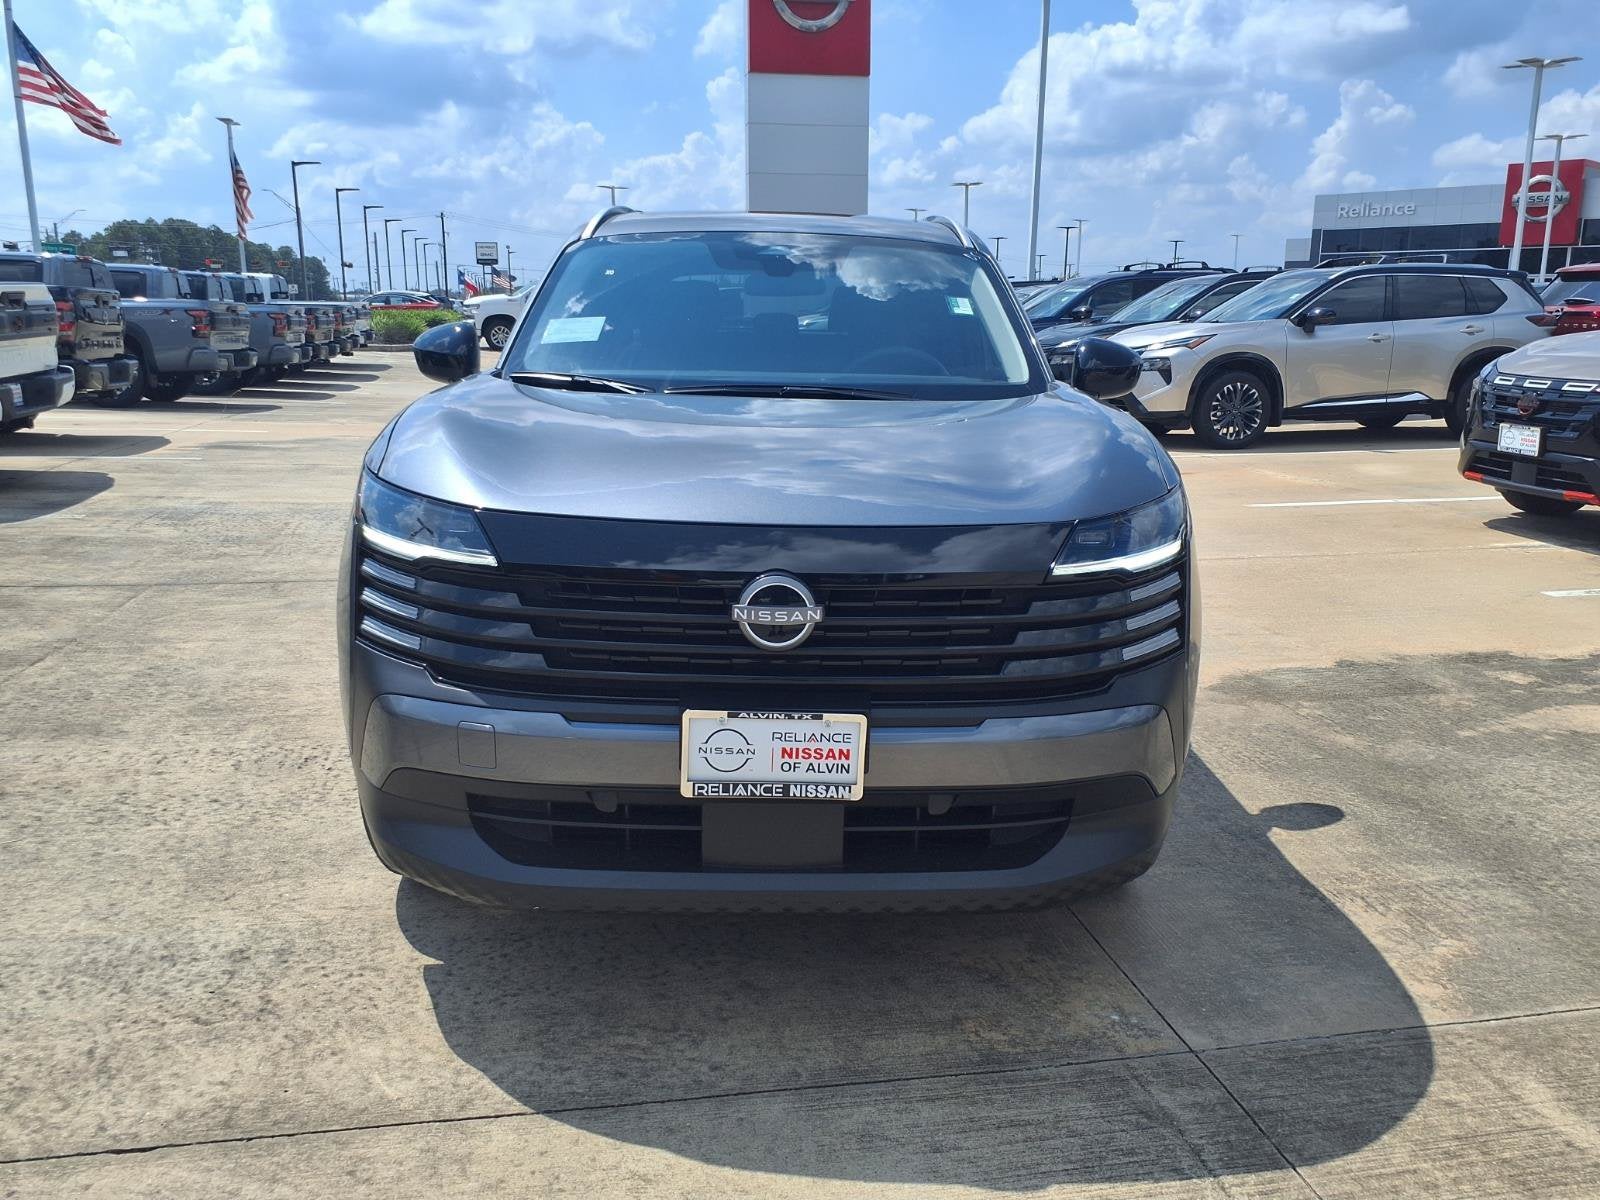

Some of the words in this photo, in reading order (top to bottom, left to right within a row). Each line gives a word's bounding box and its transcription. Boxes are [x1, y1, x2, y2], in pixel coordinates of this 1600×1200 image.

[1336, 200, 1416, 219] Reliance
[733, 608, 821, 622] NISSAN
[771, 731, 852, 744] RELIANCE
[698, 746, 756, 756] NISSAN
[780, 746, 851, 761] NISSAN
[780, 761, 801, 773] OF
[805, 762, 851, 774] ALVIN
[694, 783, 784, 797] RELIANCE
[789, 784, 851, 799] NISSAN
